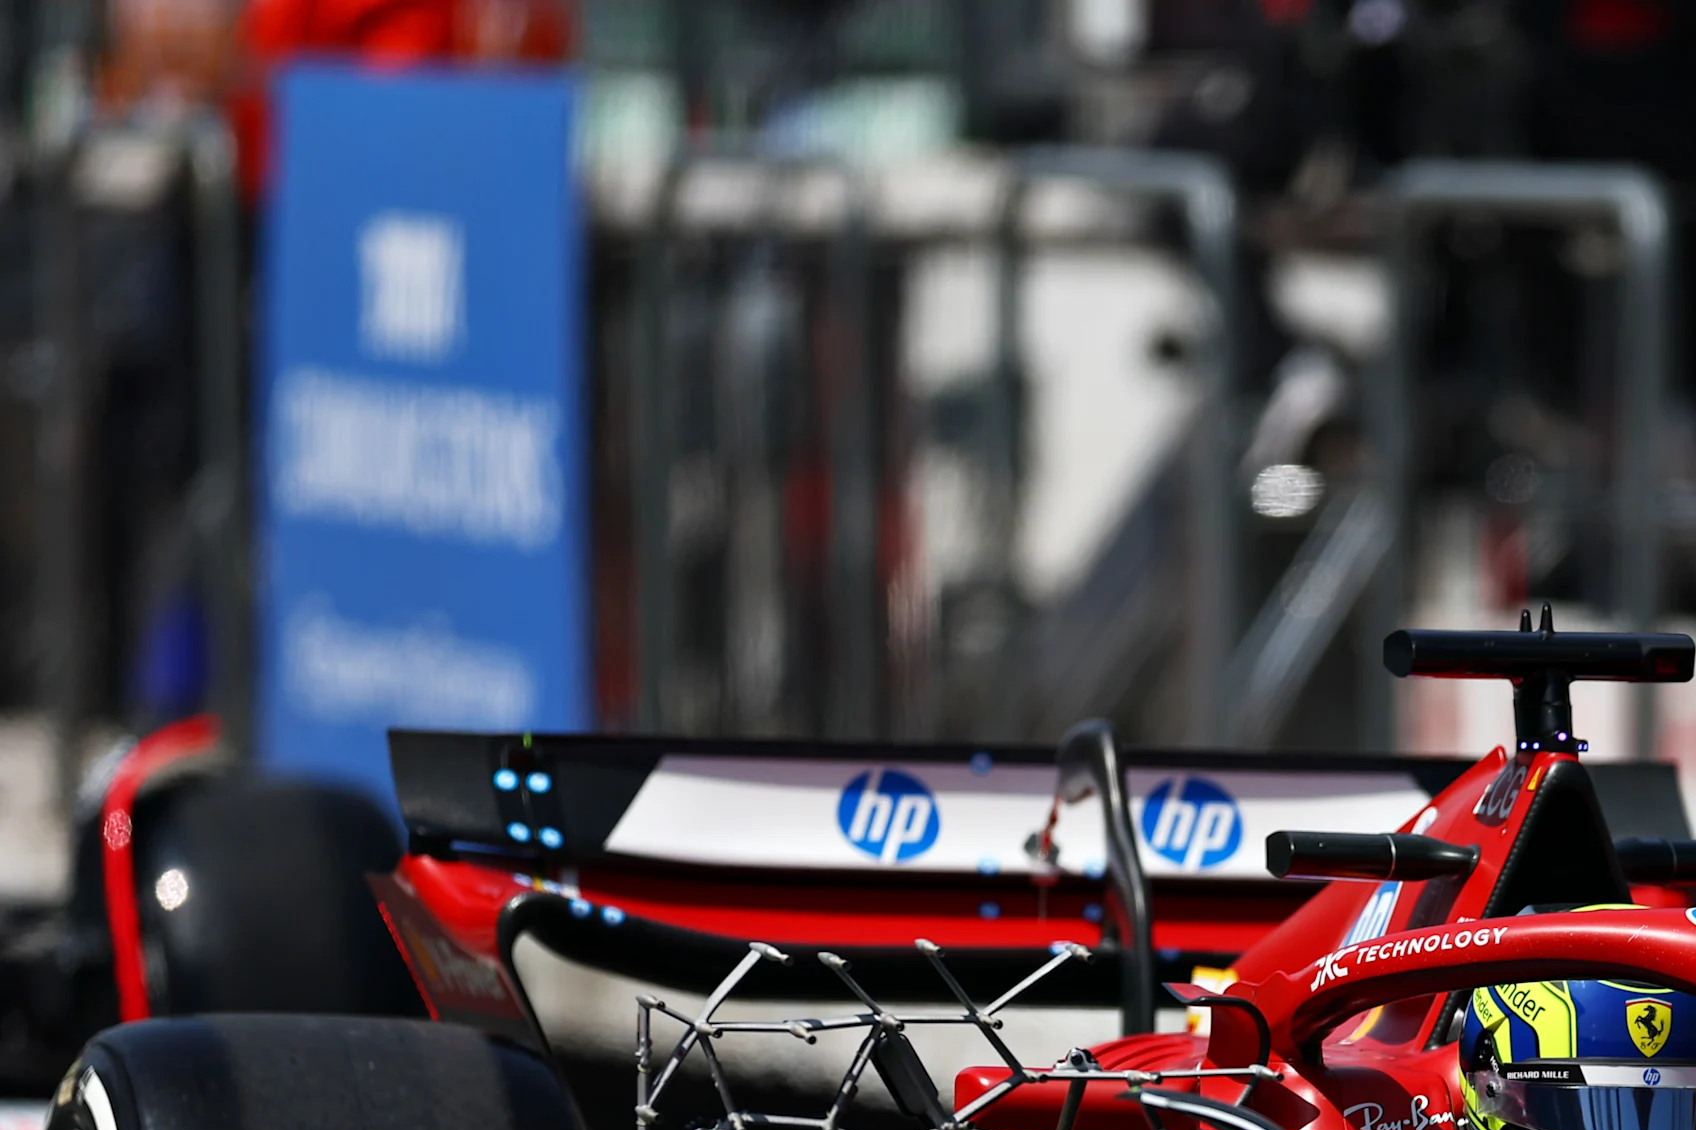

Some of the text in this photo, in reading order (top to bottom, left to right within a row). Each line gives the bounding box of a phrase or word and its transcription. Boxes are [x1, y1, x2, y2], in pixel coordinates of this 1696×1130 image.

[838, 766, 941, 866] hp
[1142, 773, 1243, 872] hp
[1356, 927, 1508, 965] TECHNOLOGY
[1507, 1070, 1570, 1080] RICHARD MILLE
[1642, 1067, 1661, 1086] hp
